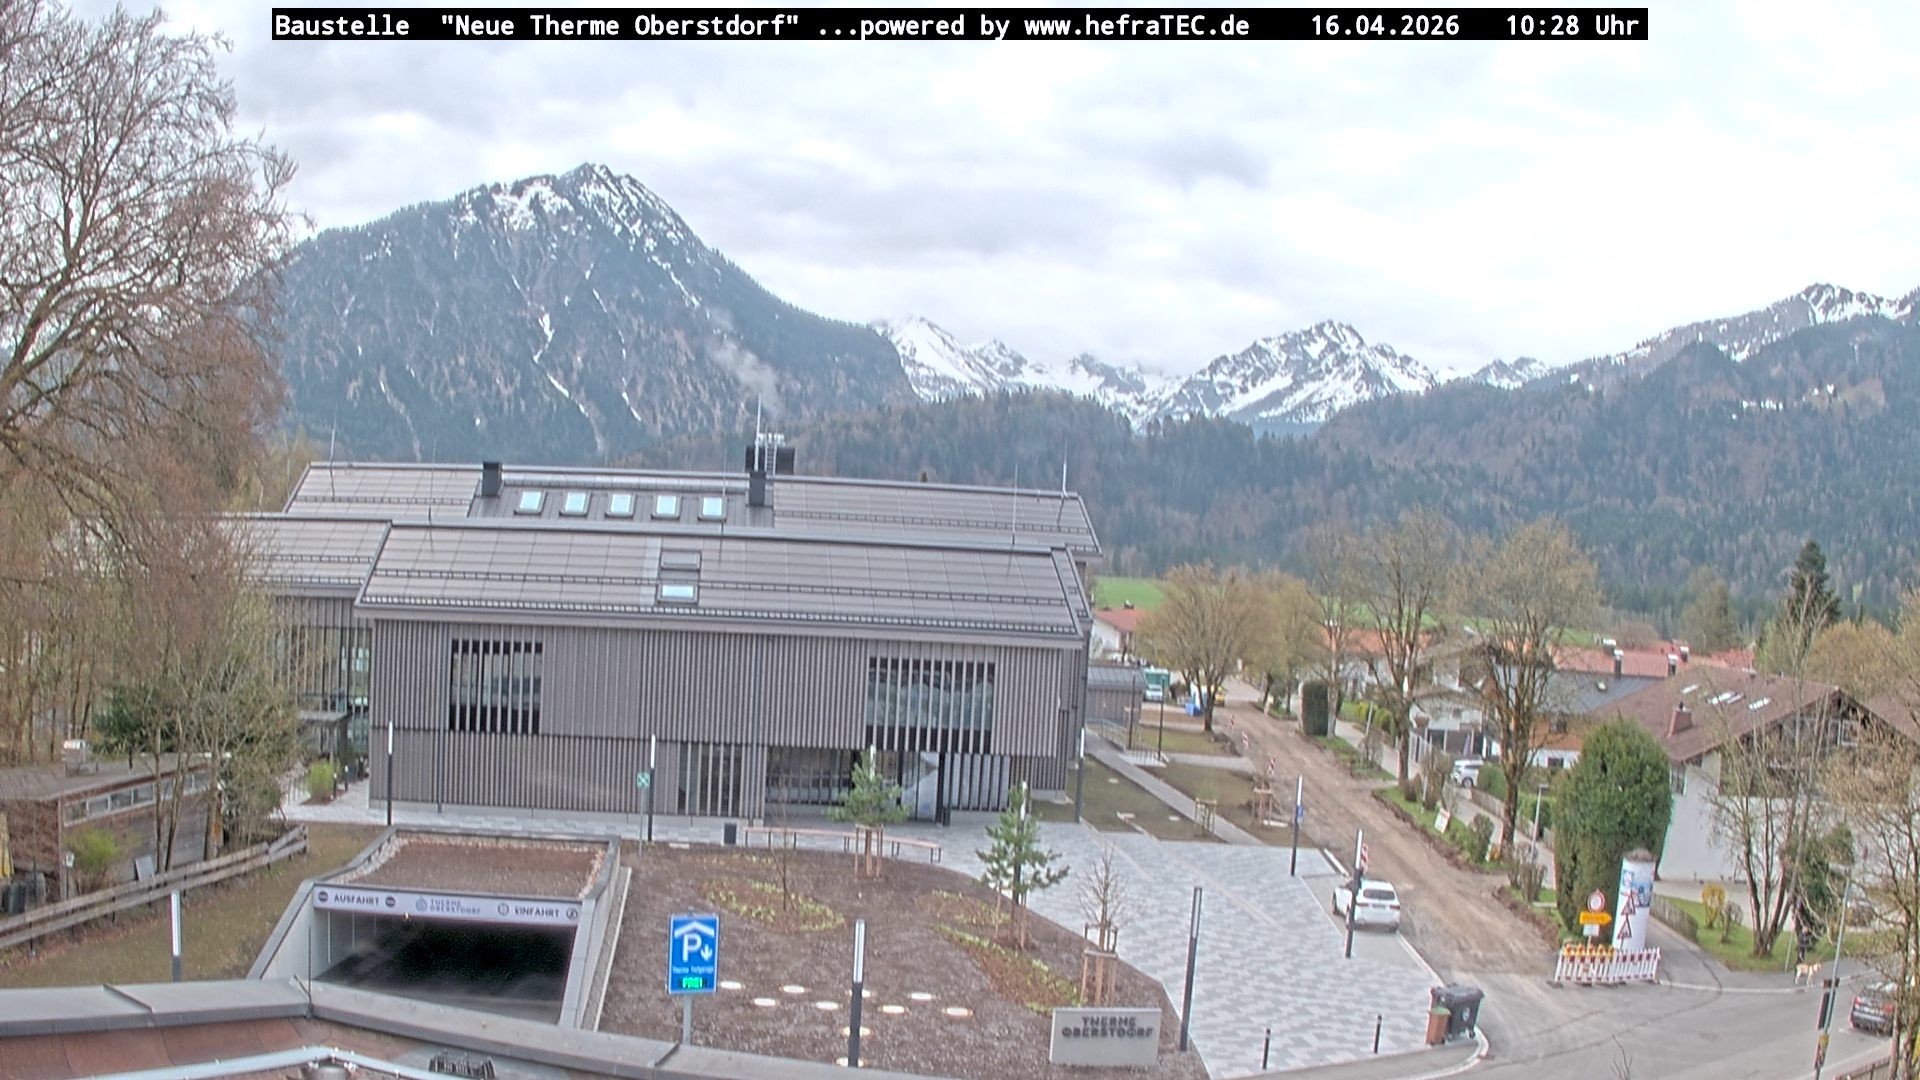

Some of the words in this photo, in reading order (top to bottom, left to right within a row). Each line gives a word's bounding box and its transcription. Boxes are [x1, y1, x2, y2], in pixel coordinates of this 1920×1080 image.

[333, 893, 379, 906] AUSFAHRT
[514, 906, 560, 918] EINFAHRT
[682, 933, 702, 963] P
[1082, 1016, 1137, 1027] THERME
[1062, 1026, 1154, 1038] OBERSTDORF
